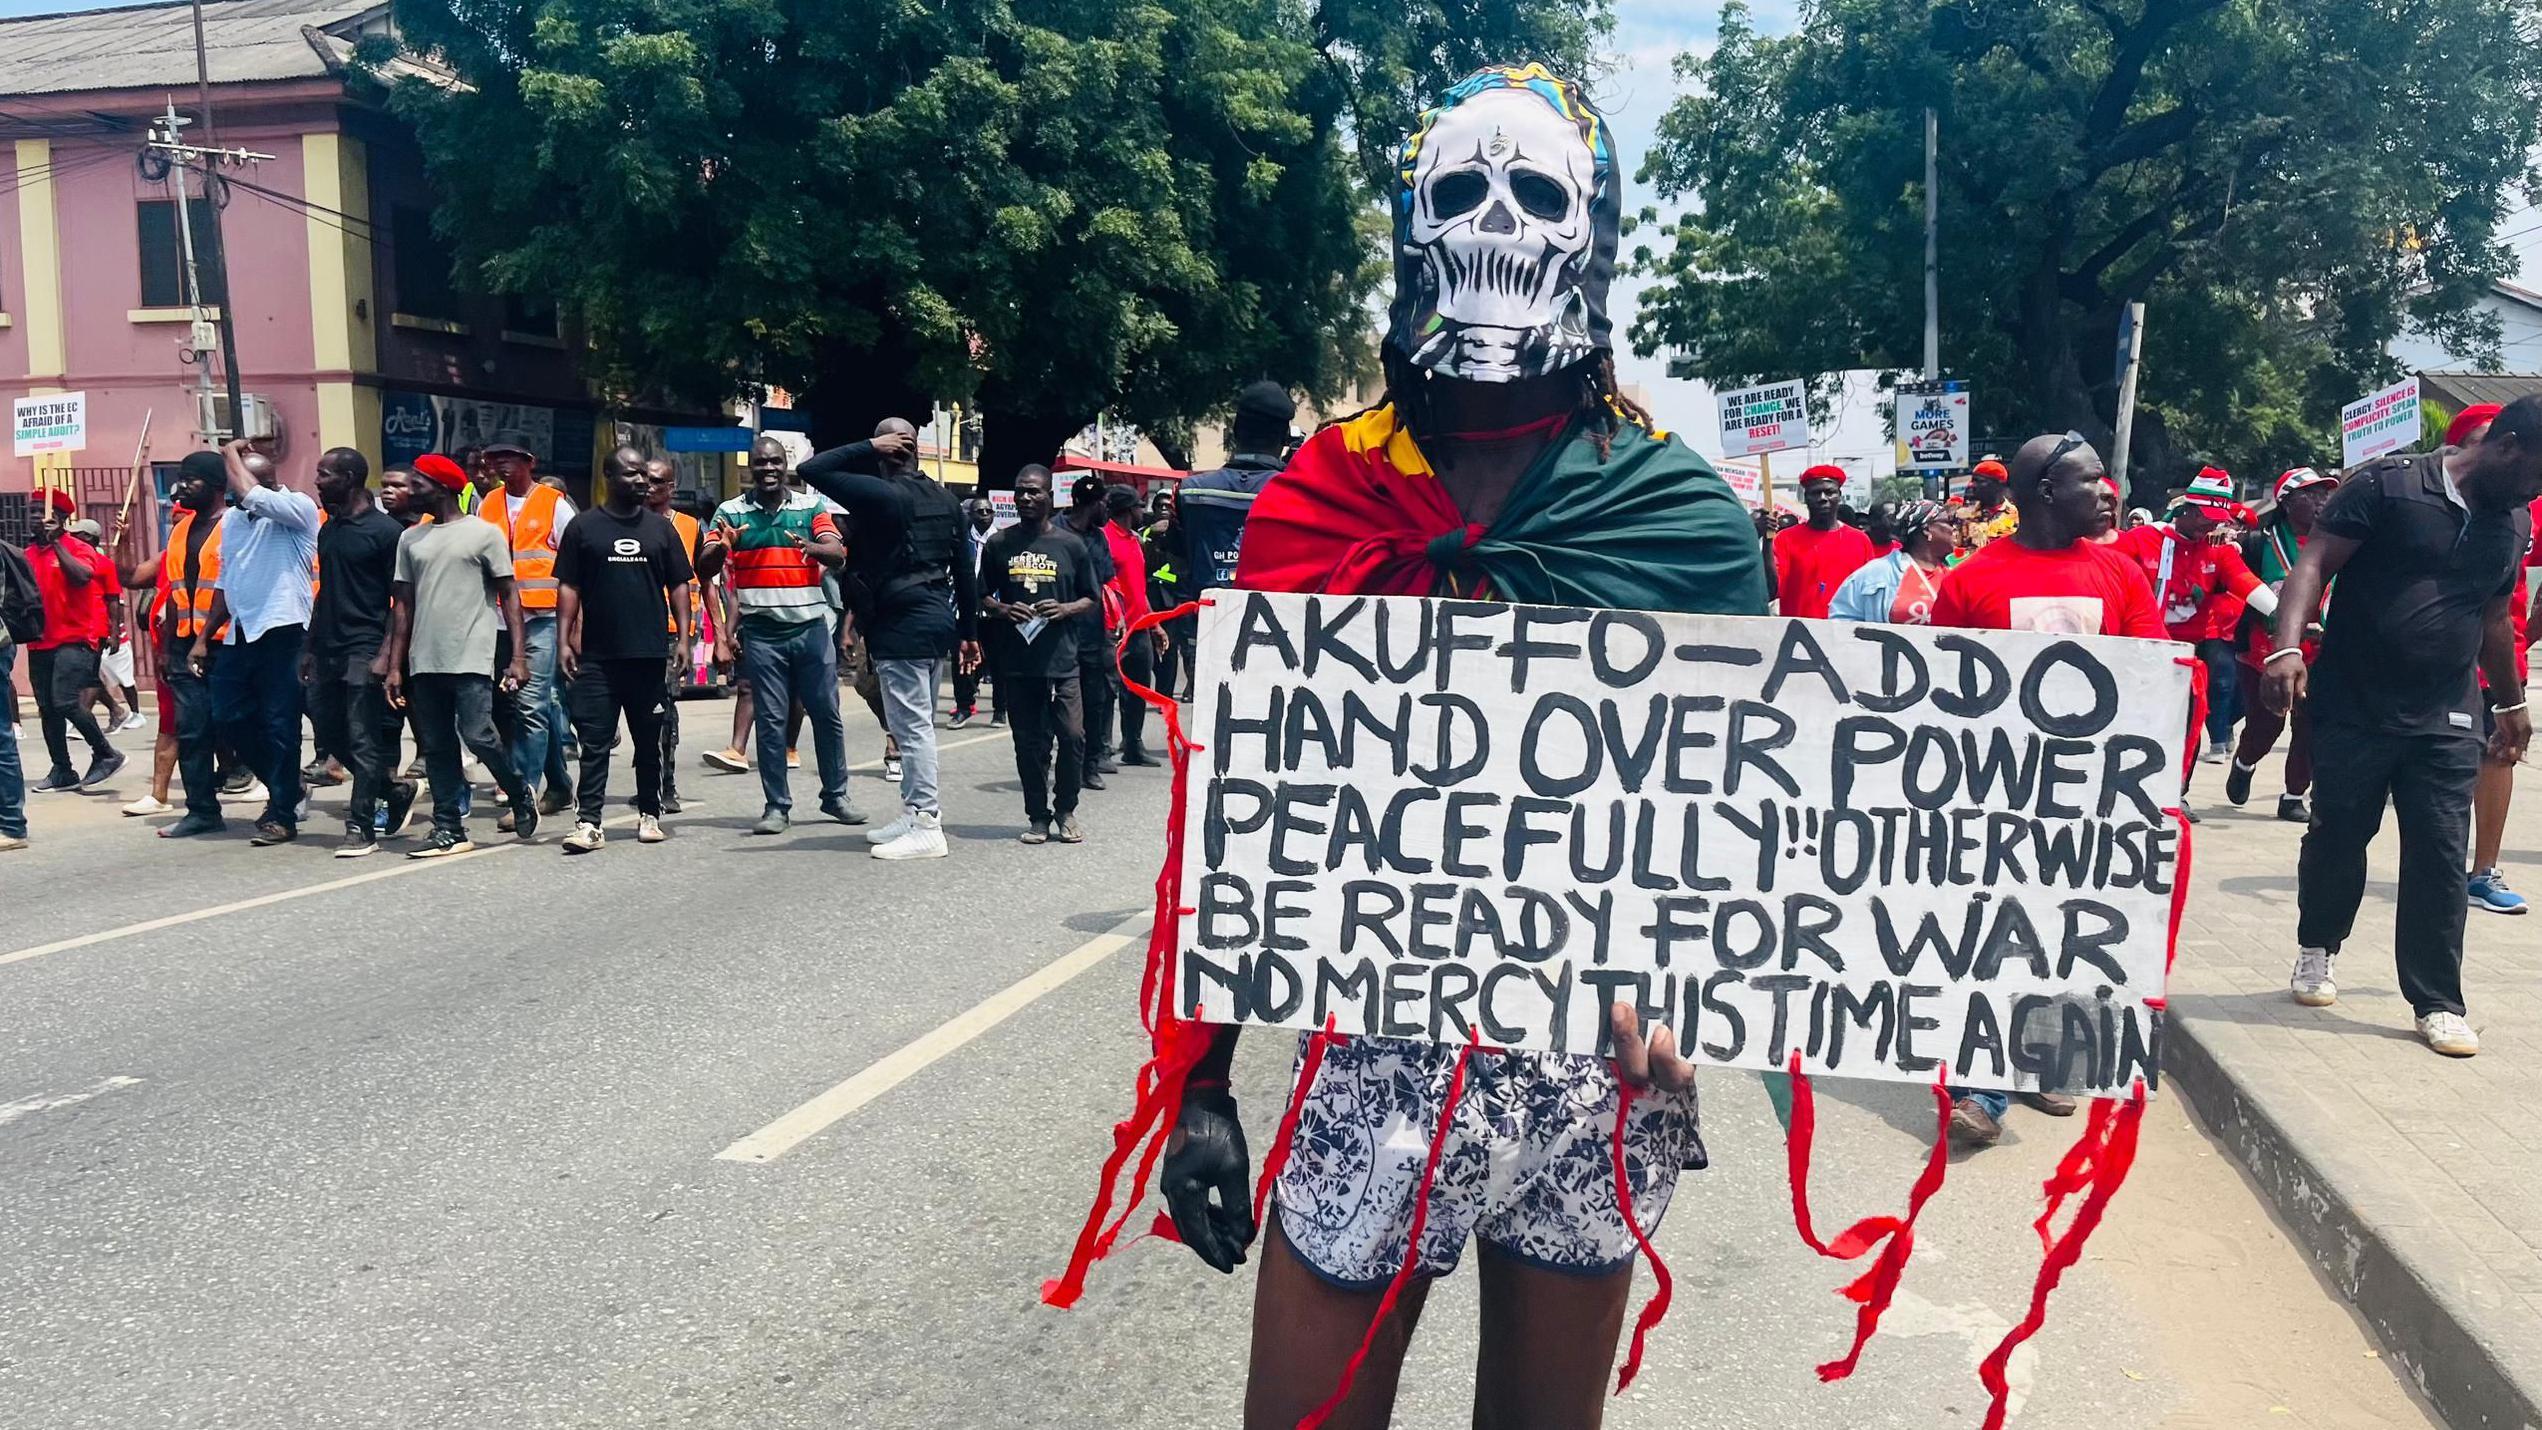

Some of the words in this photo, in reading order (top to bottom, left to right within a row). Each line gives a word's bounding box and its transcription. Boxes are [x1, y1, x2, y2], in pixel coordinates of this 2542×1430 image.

[1727, 396, 1743, 407] WE
[1744, 391, 1762, 404] ARE
[1764, 386, 1794, 400] READY
[2375, 389, 2406, 409] SILENCE
[2407, 385, 2416, 396] IS
[2392, 397, 2417, 414] SPEAK
[17, 406, 37, 417] WHY
[39, 405, 48, 415] IS
[49, 403, 65, 414] THE
[67, 402, 78, 412] EC
[1724, 408, 1742, 419] FOR
[1785, 397, 1801, 408] WE
[1914, 409, 1951, 419] MORE
[22, 416, 53, 428] AFRAID
[55, 414, 65, 424] OF
[67, 414, 73, 424] A
[1725, 418, 1742, 431] ARE
[1744, 414, 1774, 428] READY
[1776, 411, 1795, 423] FOR
[1796, 408, 1803, 419] A
[1911, 420, 1954, 430] GAMES
[2348, 425, 2373, 442] TRUTH
[2374, 421, 2384, 432] TO
[2385, 410, 2413, 428] POWER
[16, 427, 47, 440] SIMPLE
[48, 425, 80, 436] AUDIT?
[1748, 424, 1781, 439] RESET!
[1214, 551, 1225, 559] GH
[1213, 679, 1489, 786] HAND
[1519, 691, 1800, 798] OVER
[1831, 716, 2166, 829] POWER
[1820, 806, 2177, 895] OTHERWISE
[1197, 872, 1316, 950] BE
[1340, 880, 1613, 966] READY
[1640, 892, 1846, 973] FOR
[1870, 891, 2129, 986] WAR
[1183, 948, 1304, 1023] NO
[1314, 956, 1572, 1053] MERCY
[1580, 970, 1747, 1062] THIS
[1750, 974, 1948, 1072] TIME
[1955, 985, 2163, 1094] AGAIN
